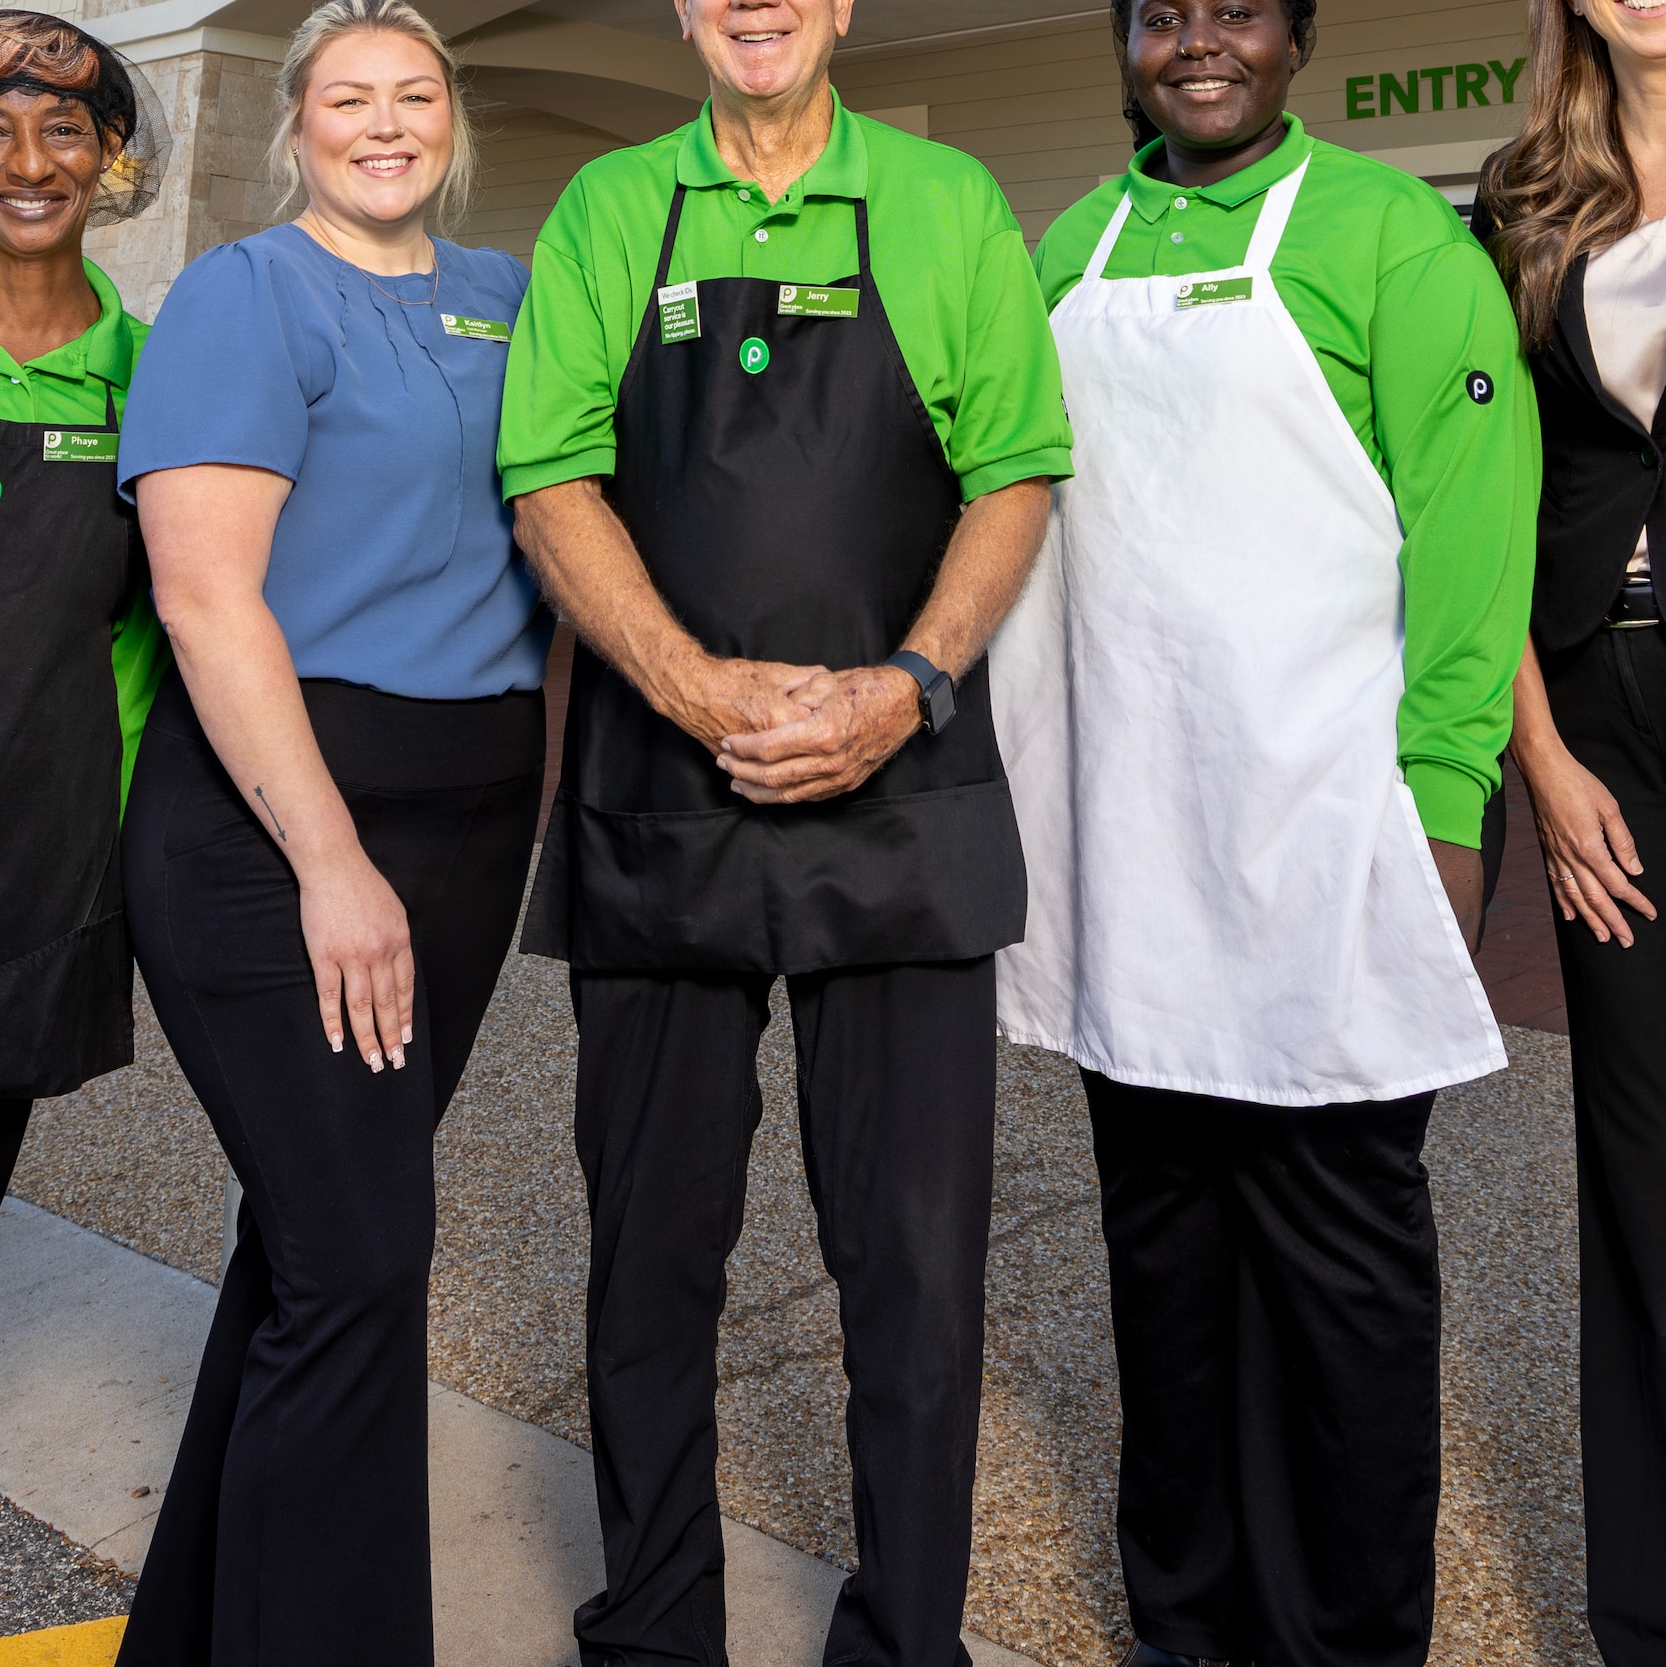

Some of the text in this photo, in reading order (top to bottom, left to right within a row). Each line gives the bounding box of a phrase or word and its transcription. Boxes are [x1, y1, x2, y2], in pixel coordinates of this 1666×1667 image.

[1346, 57, 1528, 120] ENTRY
[1201, 284, 1219, 292] Ally
[671, 289, 684, 298] check
[807, 291, 829, 302] Jerry
[663, 304, 685, 315] Carryout
[664, 313, 681, 322] service
[464, 319, 491, 329] Kaitlyn
[71, 436, 98, 447] Phaye
